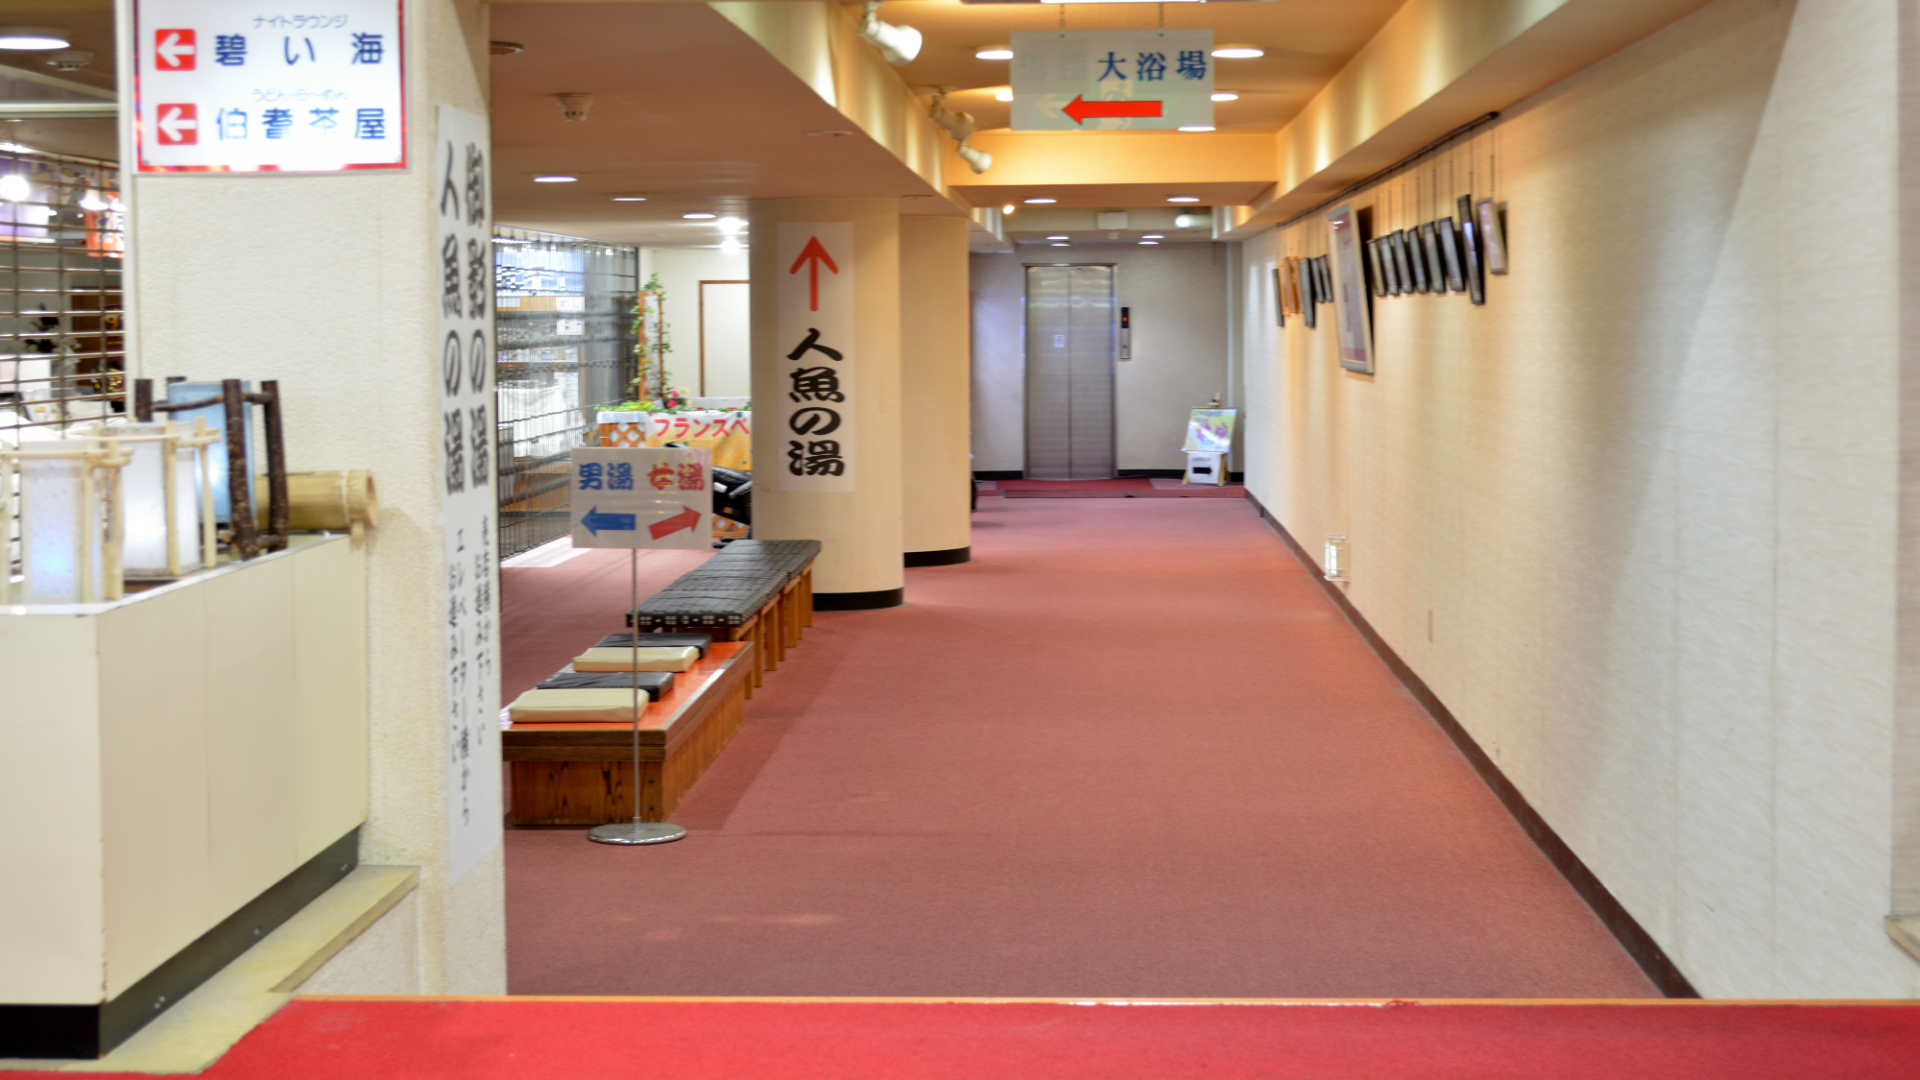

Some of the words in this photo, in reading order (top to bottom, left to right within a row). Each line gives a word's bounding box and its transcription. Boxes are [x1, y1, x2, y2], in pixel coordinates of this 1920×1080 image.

[252, 14, 348, 29] ナイトラウンジ
[213, 33, 384, 66] 碧い海
[1097, 50, 1207, 82] 大浴場
[216, 107, 386, 141] 伯耆茶屋
[440, 140, 465, 494] 人魚の湯
[786, 327, 845, 477] 人魚の湯
[578, 461, 635, 491] 男湯
[647, 462, 706, 492] 女湯
